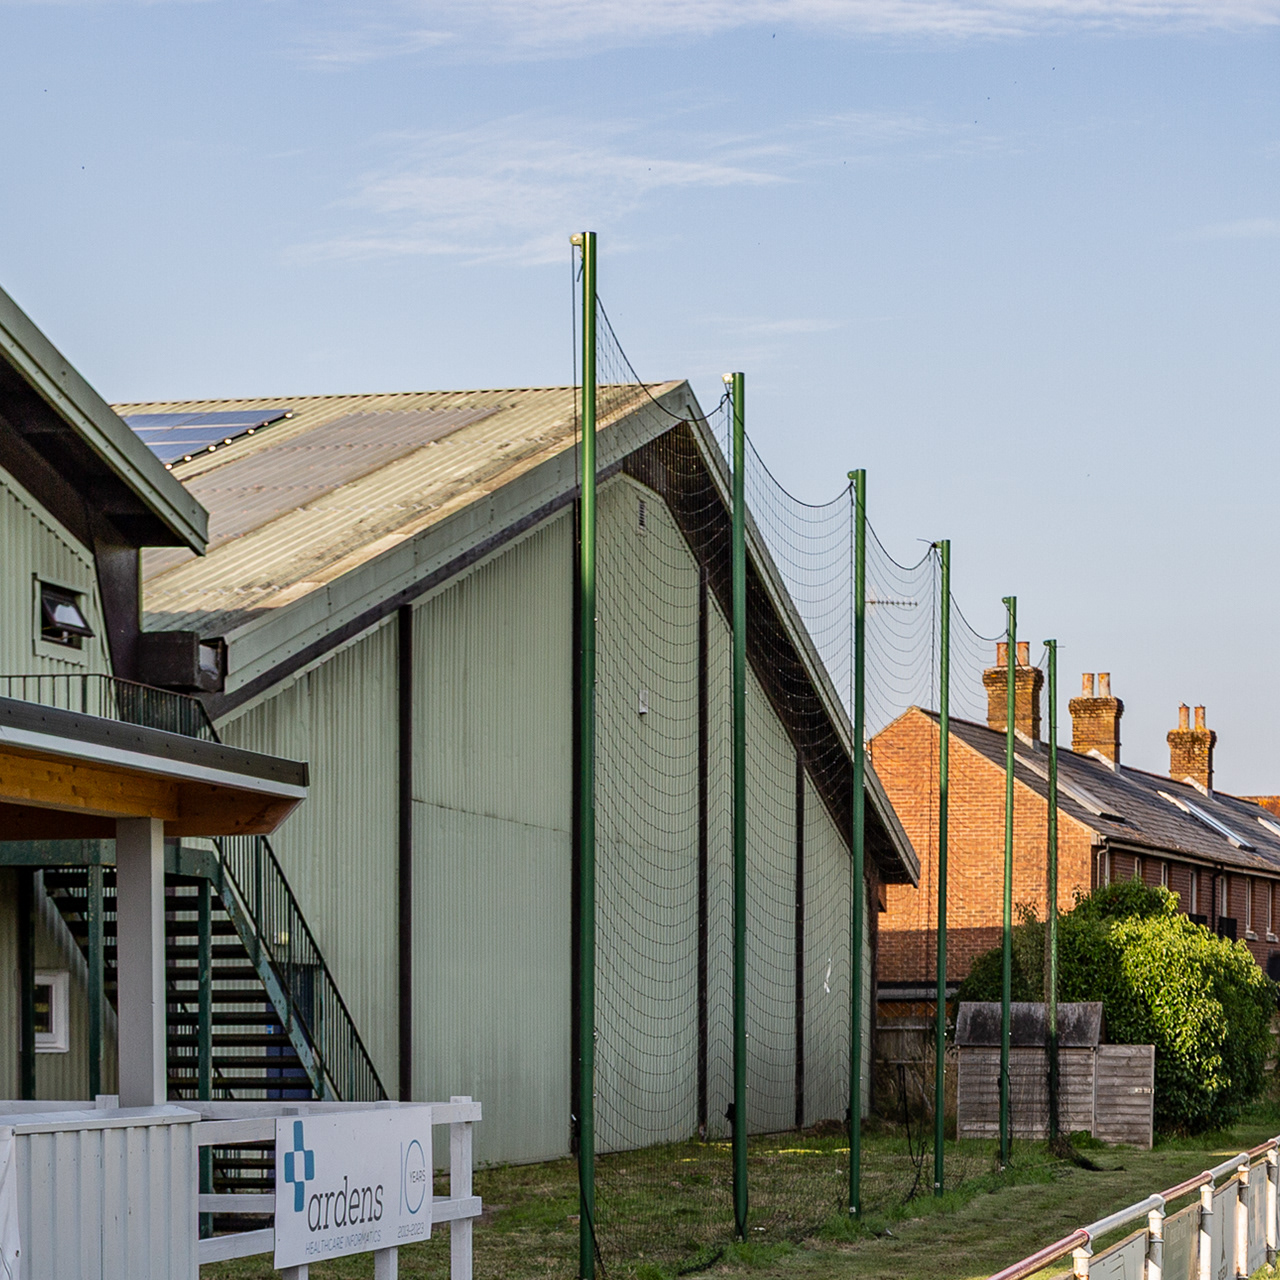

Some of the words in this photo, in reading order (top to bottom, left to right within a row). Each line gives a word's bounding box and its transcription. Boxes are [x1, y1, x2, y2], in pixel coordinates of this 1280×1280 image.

[409, 1170, 426, 1184] YEARS
[307, 1175, 384, 1233] ardens
[305, 1236, 344, 1256] HEALTHCARE
[345, 1229, 382, 1248] INFORMATICS
